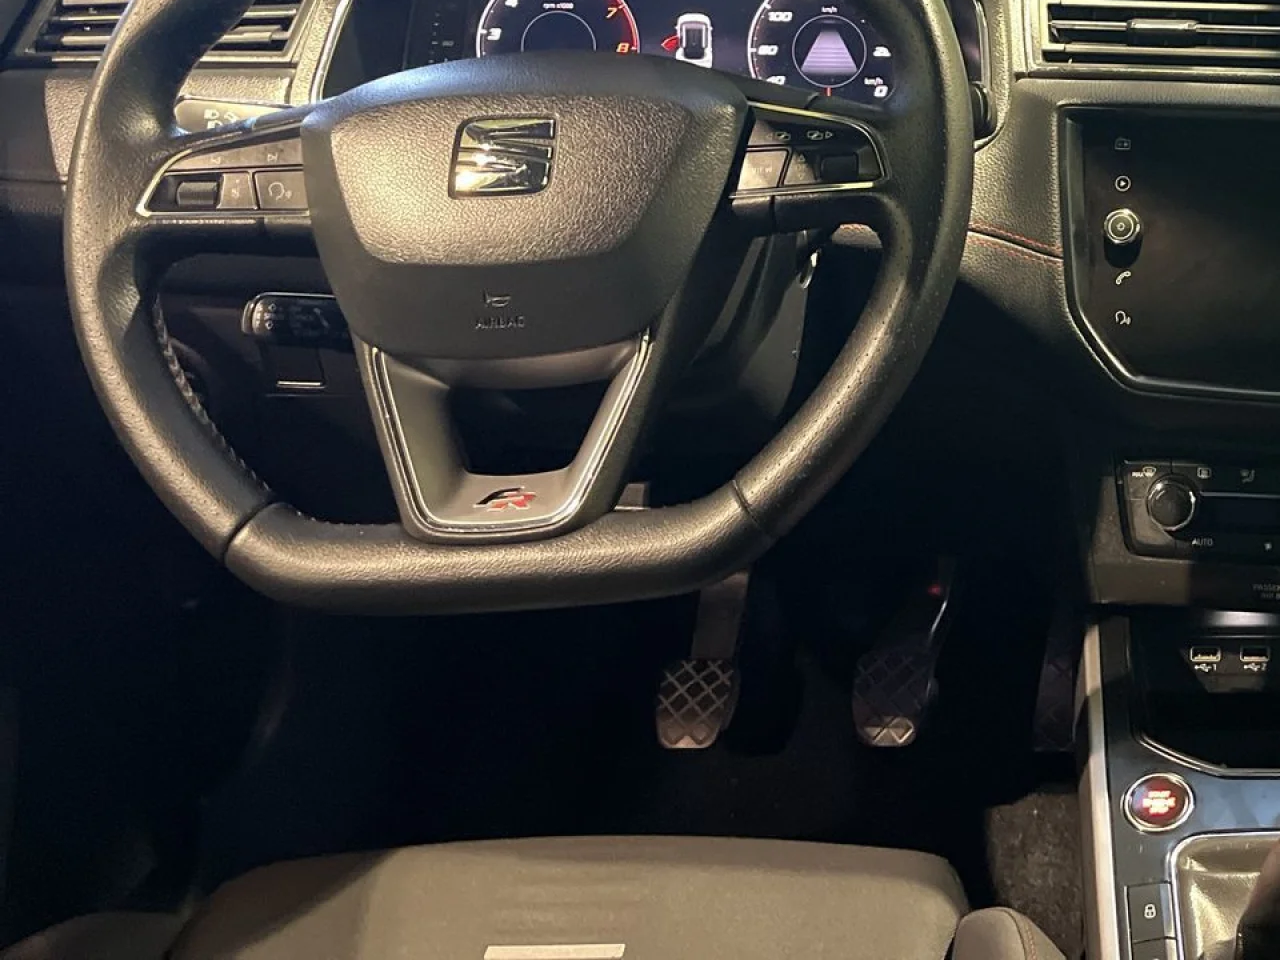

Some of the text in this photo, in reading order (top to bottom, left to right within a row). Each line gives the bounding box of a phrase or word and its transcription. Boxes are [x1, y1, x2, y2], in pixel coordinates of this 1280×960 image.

[605, 7, 617, 19] 7
[768, 11, 793, 22] 100
[487, 28, 502, 40] 3
[616, 43, 629, 53] 8
[873, 85, 889, 97] 0
